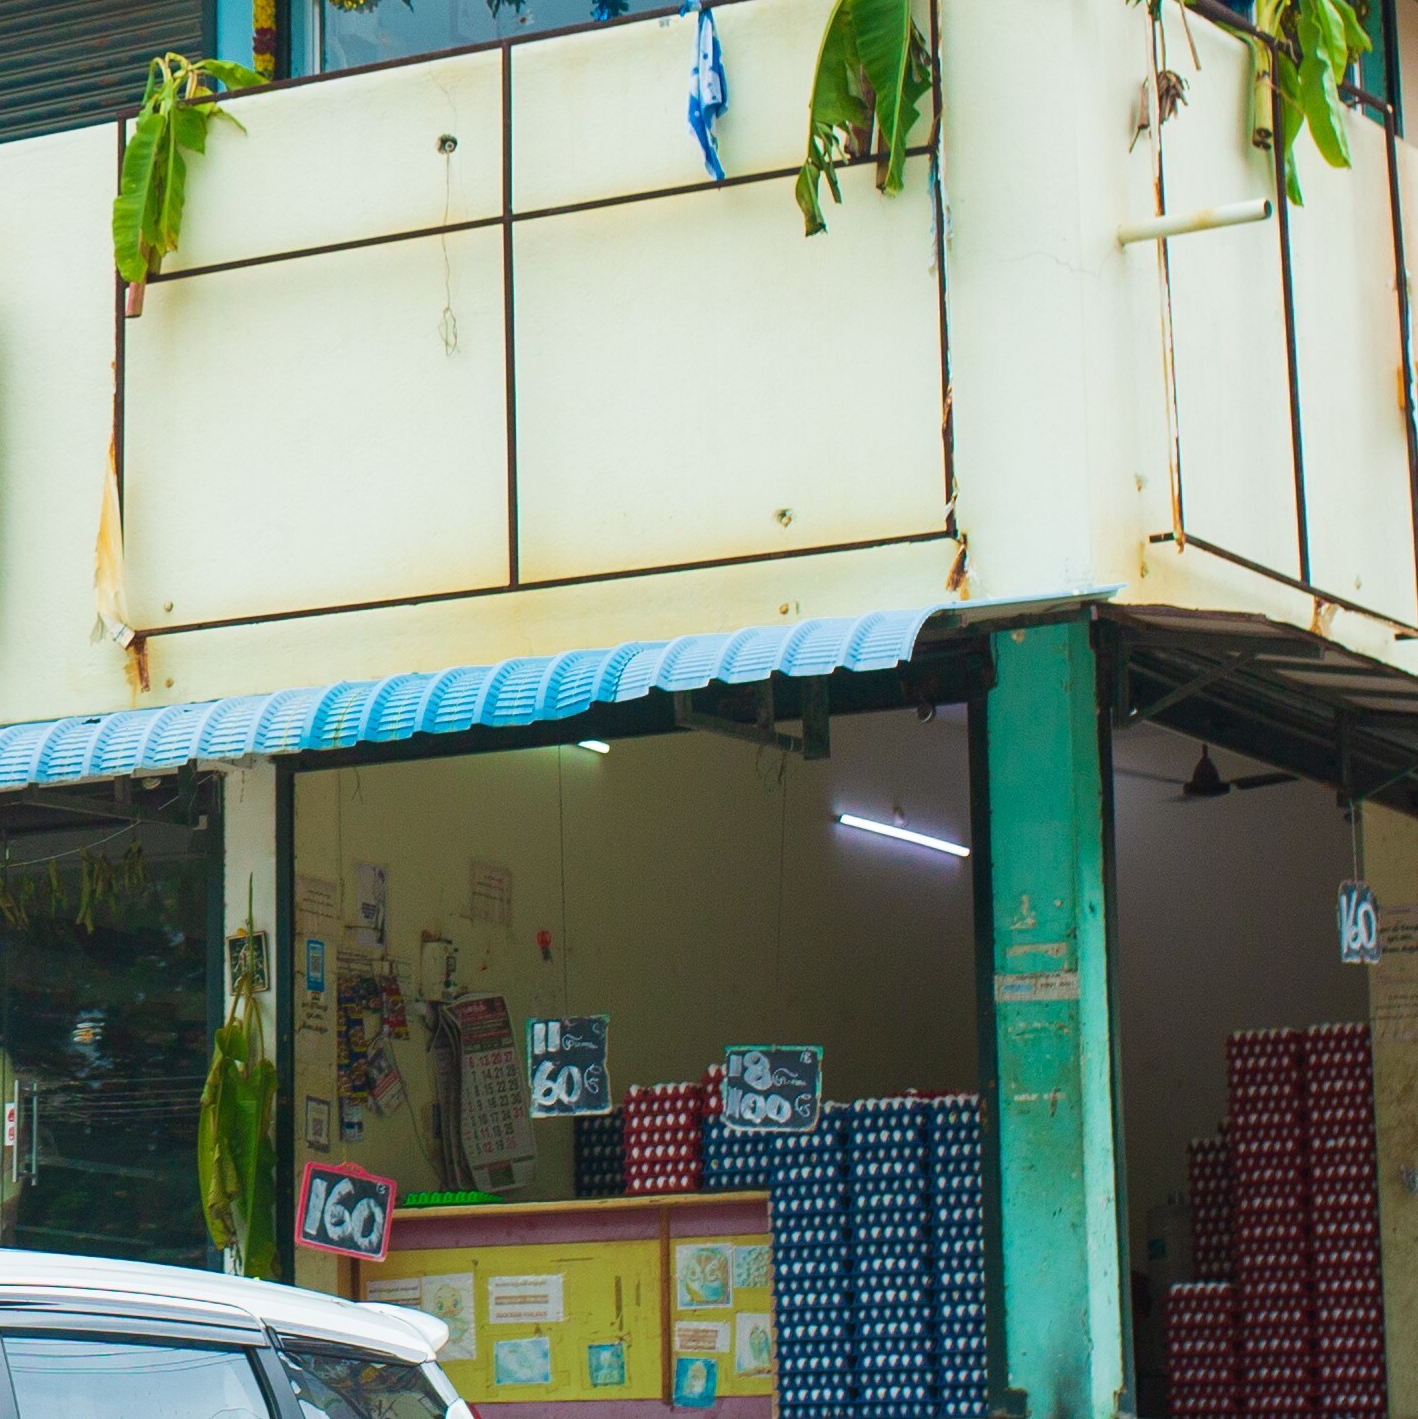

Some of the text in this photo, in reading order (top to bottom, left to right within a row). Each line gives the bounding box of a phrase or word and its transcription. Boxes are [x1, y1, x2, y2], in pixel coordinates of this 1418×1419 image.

[532, 1060, 583, 1107] 60
[728, 1050, 773, 1091] 18
[726, 1086, 792, 1124] 100
[304, 1177, 384, 1250] 160
